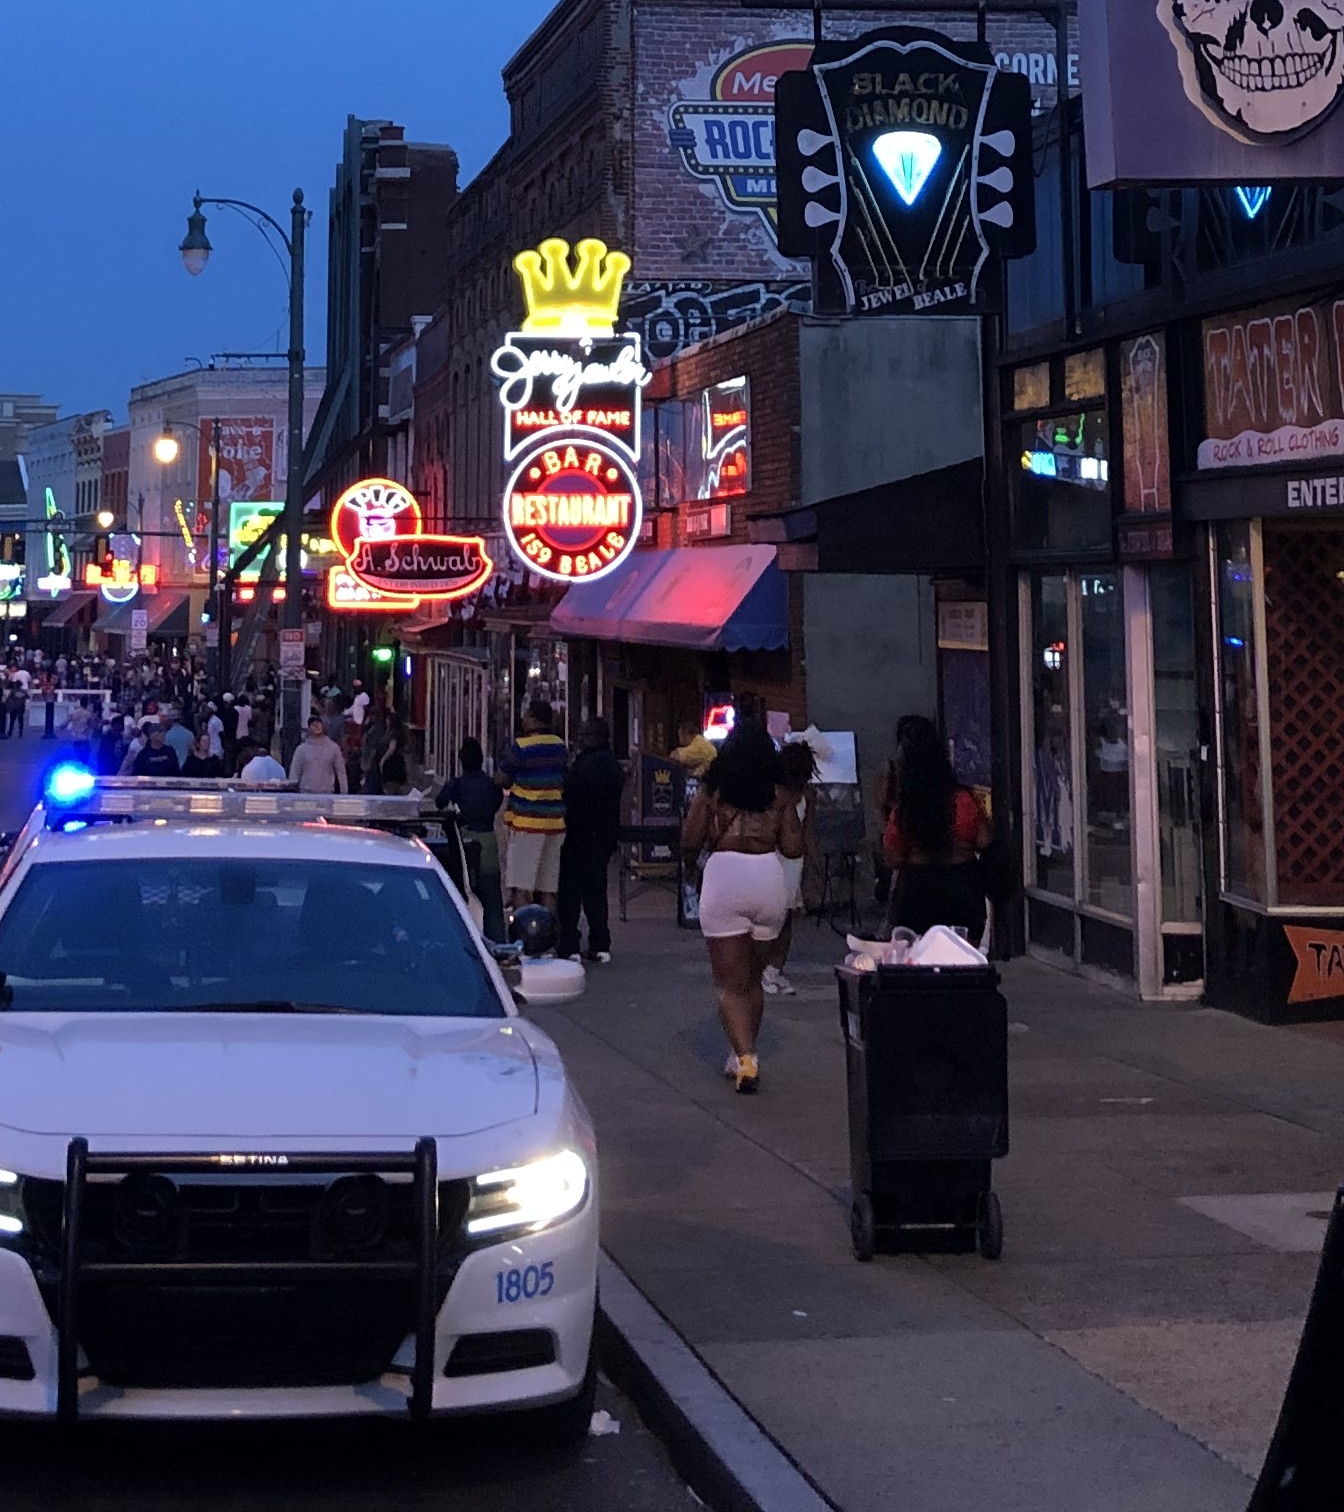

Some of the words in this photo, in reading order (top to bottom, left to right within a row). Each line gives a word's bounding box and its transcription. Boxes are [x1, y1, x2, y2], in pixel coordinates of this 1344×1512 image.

[850, 71, 960, 95] BLACK
[846, 97, 969, 133] DIAMOND
[703, 119, 775, 160] ROC
[912, 281, 968, 310] BEALE
[1206, 306, 1323, 425] TATER
[516, 410, 557, 426] HALL
[560, 410, 582, 425] OF
[586, 410, 631, 426] FAME
[542, 445, 603, 476] BAR
[1213, 441, 1242, 462] ROCK
[1258, 437, 1285, 456] ROLL
[1288, 426, 1340, 455] CLOTHING
[345, 485, 412, 513] PIG
[510, 492, 633, 528] RESTAURANT
[355, 543, 382, 571] A.
[384, 542, 484, 572] Schwab
[519, 532, 553, 565] 159
[558, 531, 626, 575] BEALE
[497, 1261, 554, 1304] 1805
